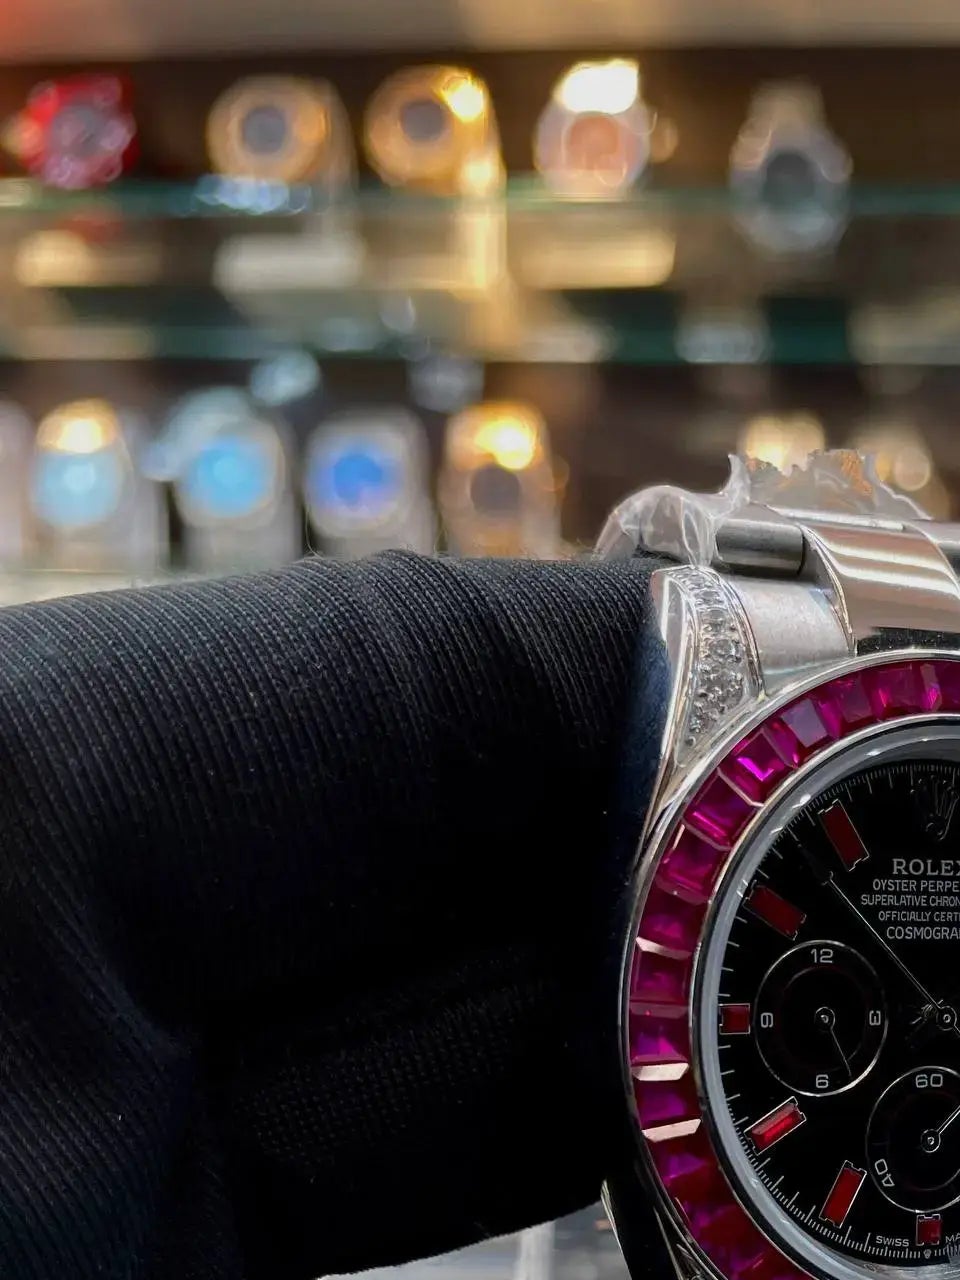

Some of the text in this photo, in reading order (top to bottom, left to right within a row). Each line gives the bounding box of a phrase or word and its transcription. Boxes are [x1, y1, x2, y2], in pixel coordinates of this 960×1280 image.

[872, 878, 917, 892] OYSTER
[861, 894, 928, 907] SUPERLATIVE
[878, 910, 931, 922] OFFICIALLY
[810, 948, 834, 964] 12
[868, 1010, 882, 1026] 3
[815, 1074, 829, 1089] 6
[915, 1073, 943, 1088] 60
[874, 1158, 895, 1187] 40
[875, 1235, 910, 1247] SWISS
